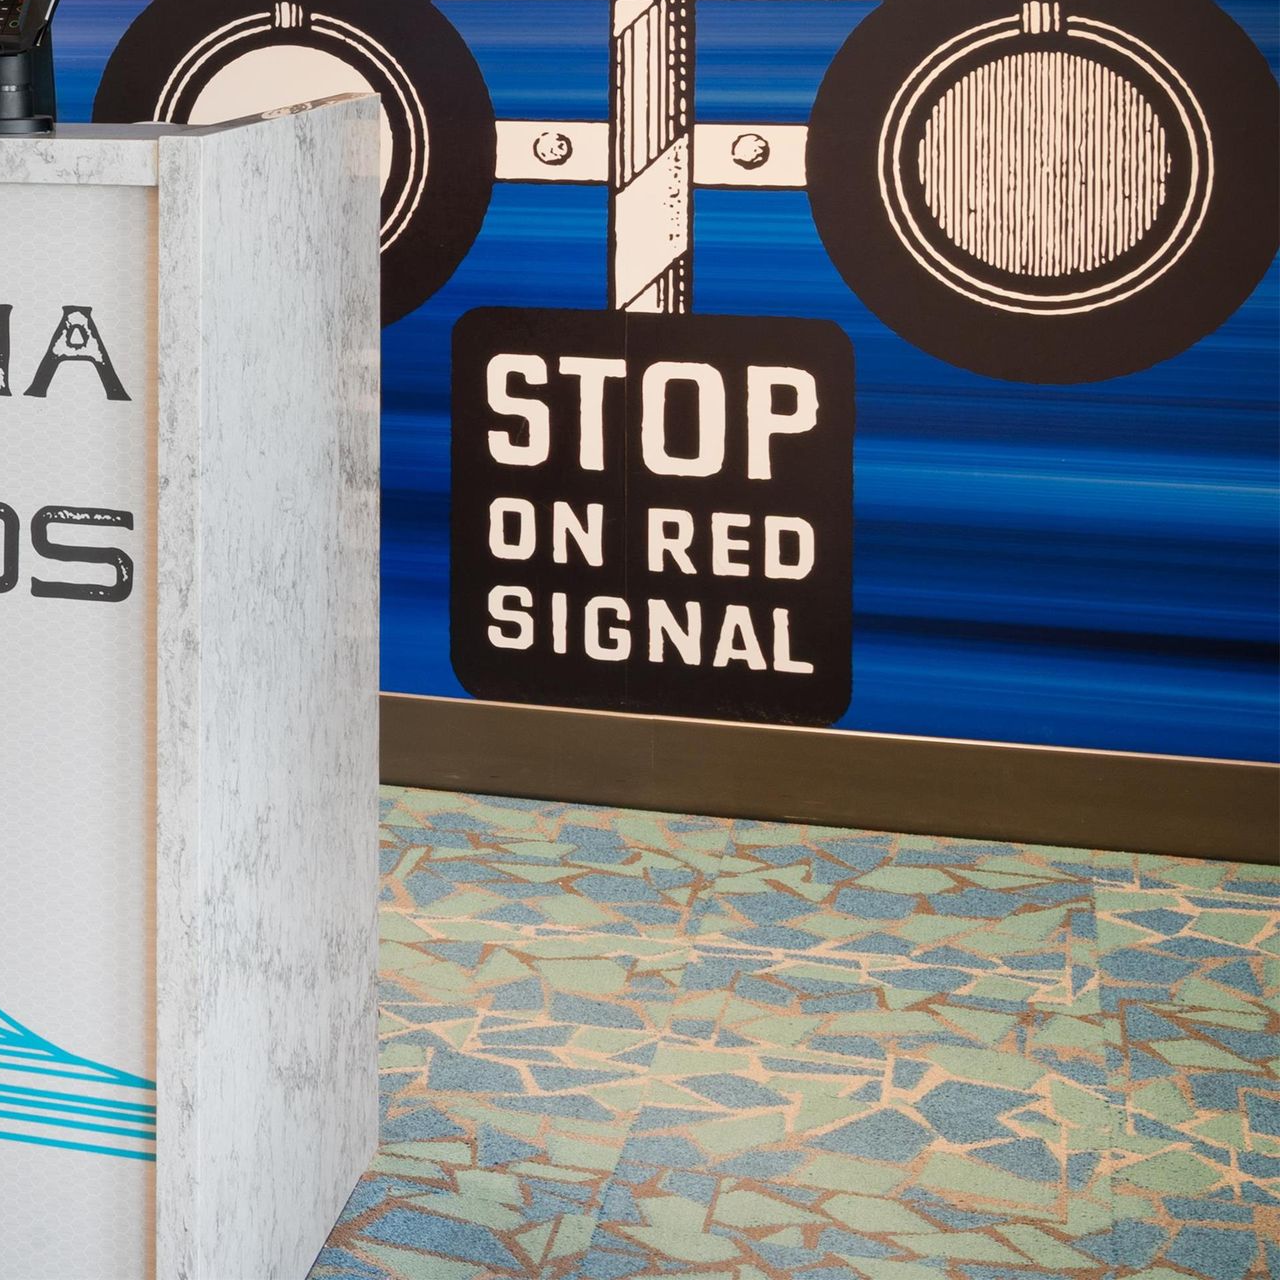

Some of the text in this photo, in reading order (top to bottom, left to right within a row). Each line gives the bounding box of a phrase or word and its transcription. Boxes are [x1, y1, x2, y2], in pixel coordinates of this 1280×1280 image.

[486, 352, 820, 480] STOP
[489, 496, 815, 581] ON RED
[487, 584, 815, 674] SIGNAL
